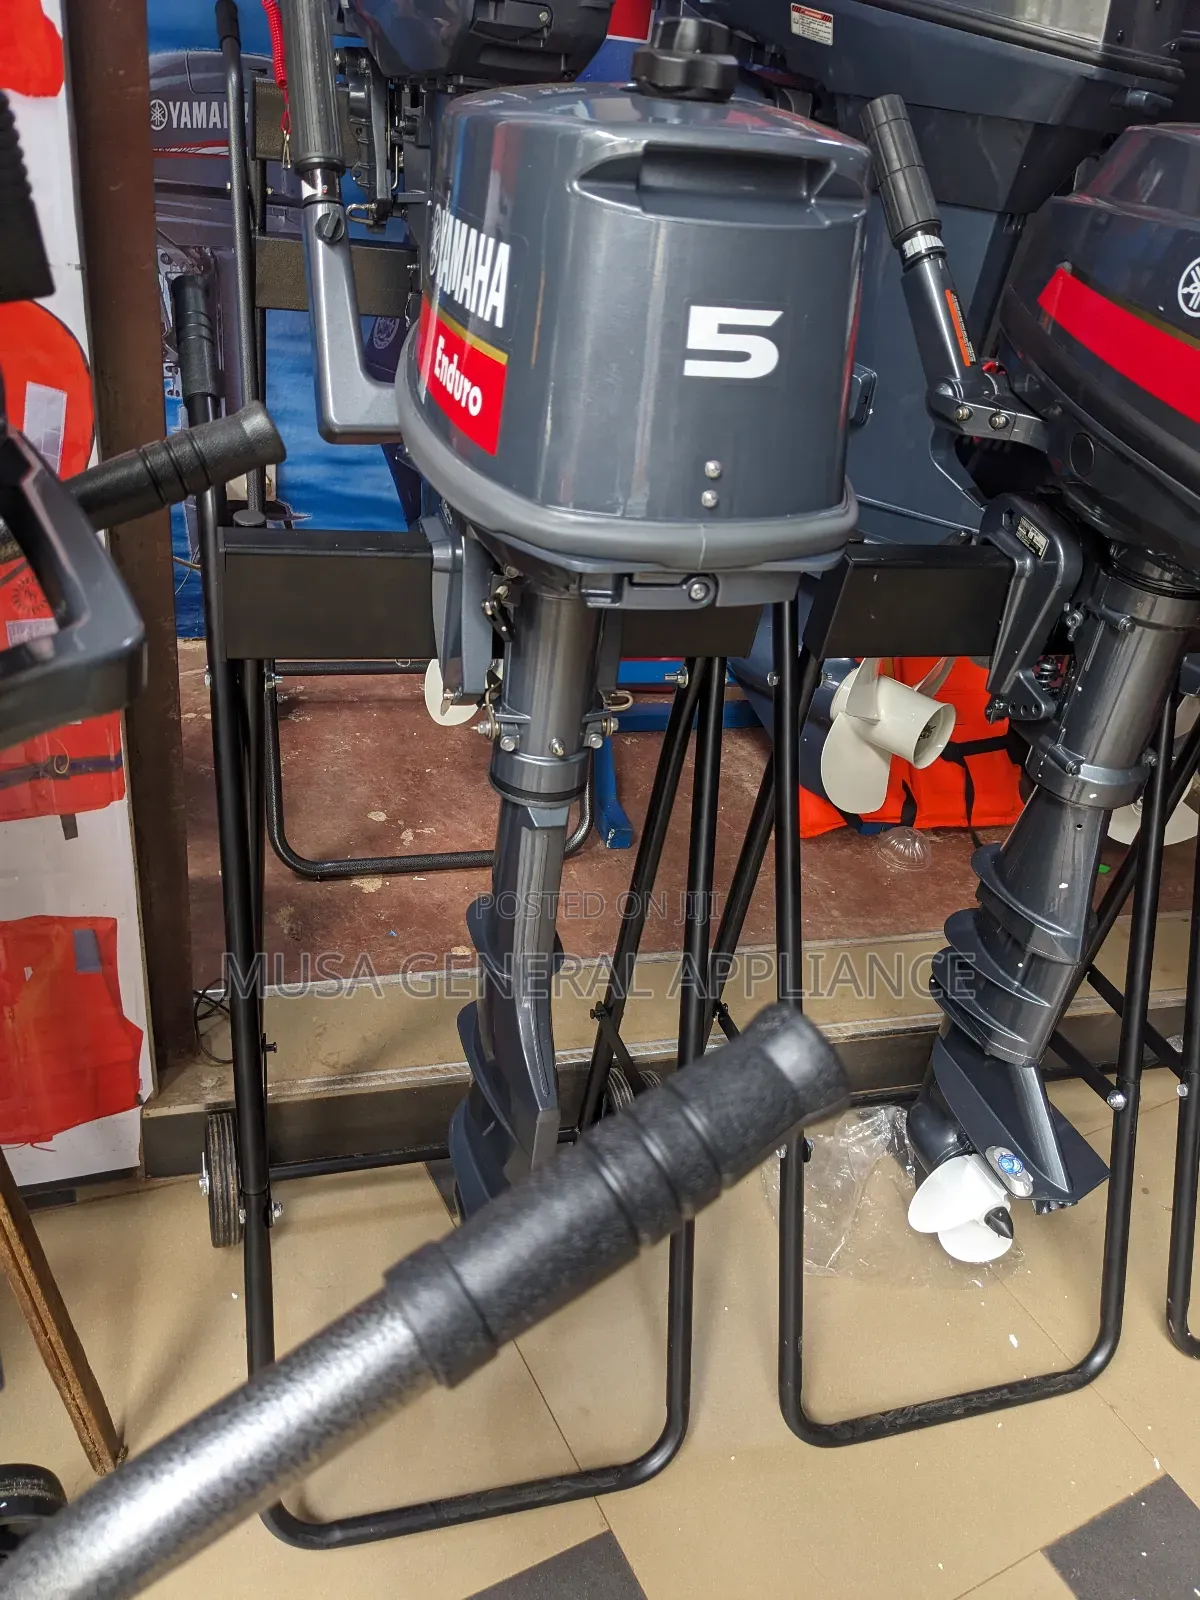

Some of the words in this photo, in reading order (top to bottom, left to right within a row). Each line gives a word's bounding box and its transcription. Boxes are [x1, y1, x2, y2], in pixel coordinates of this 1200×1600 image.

[169, 101, 248, 128] YAMA
[436, 209, 511, 329] YAMAHA
[434, 335, 483, 417] Enduro
[684, 305, 784, 379] 5
